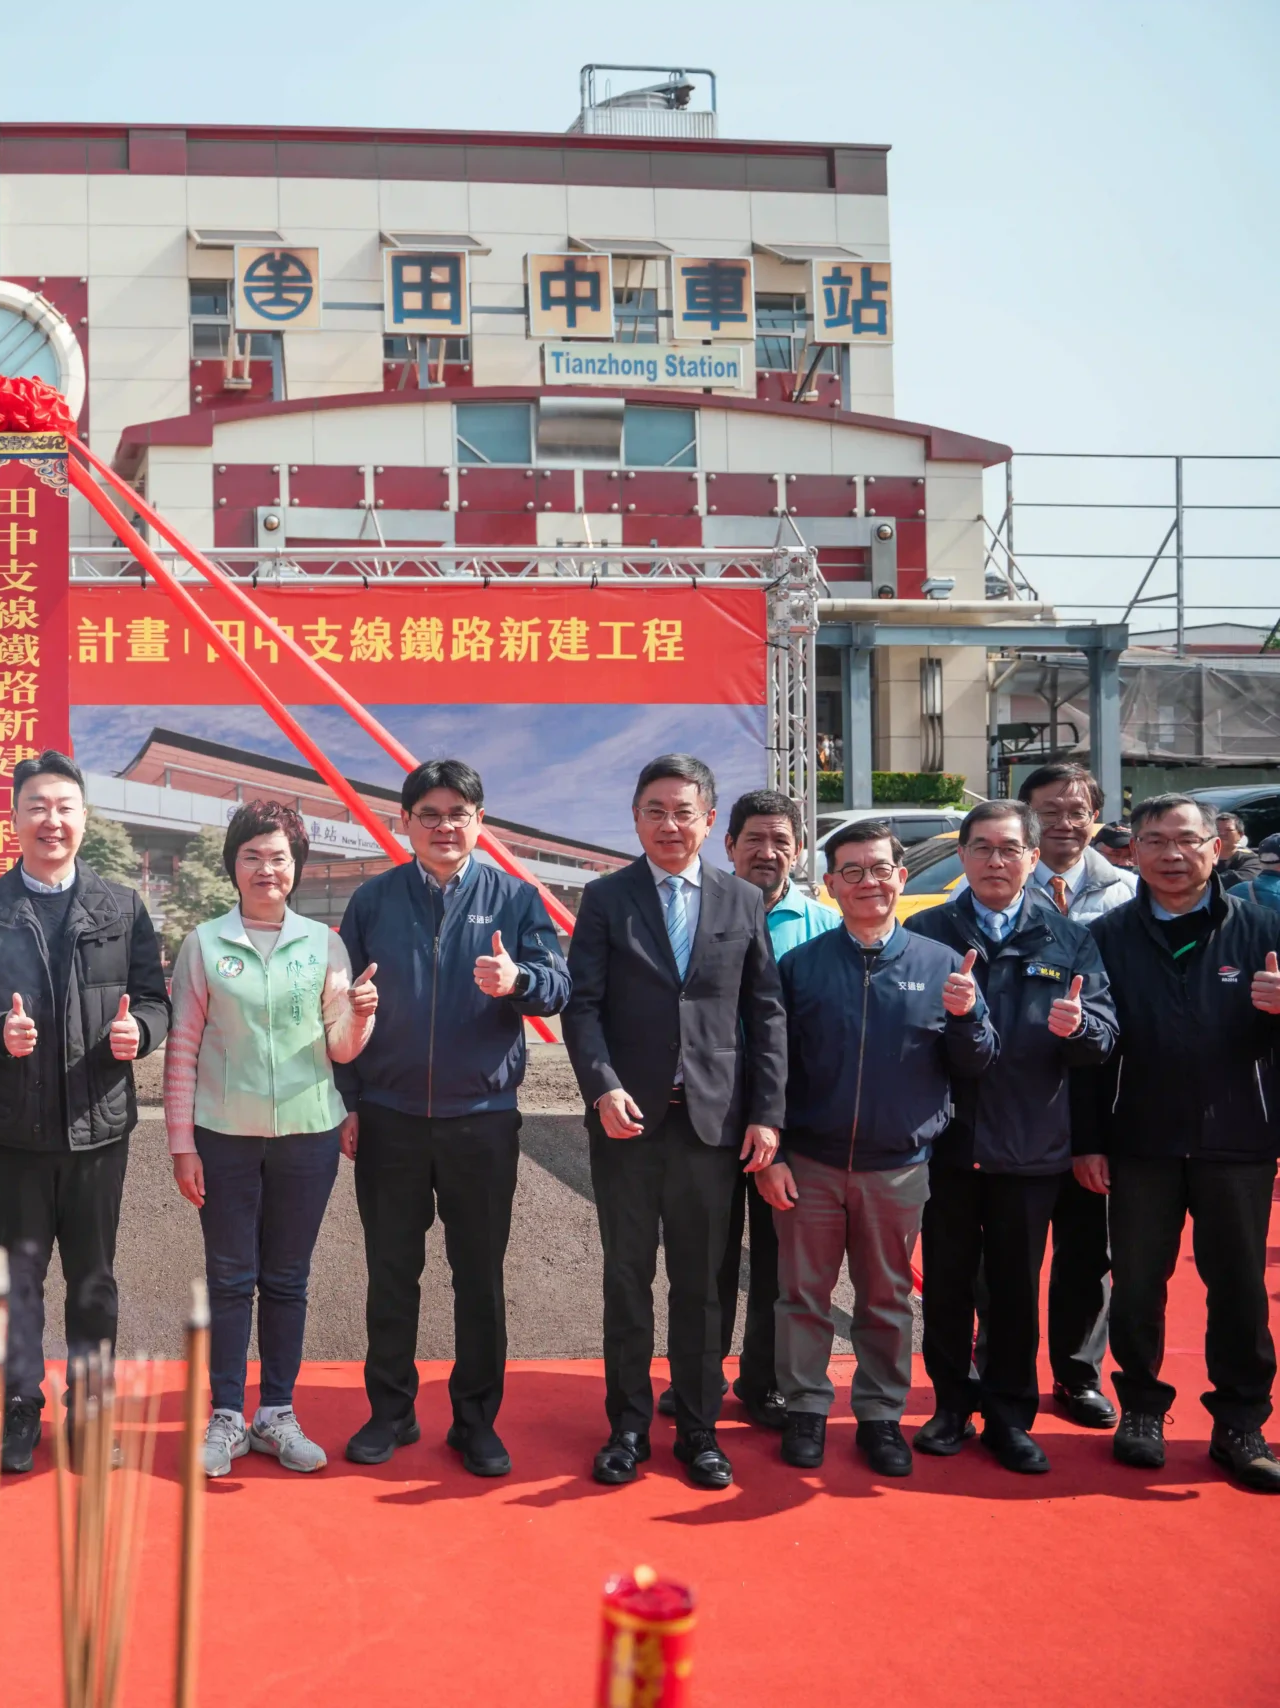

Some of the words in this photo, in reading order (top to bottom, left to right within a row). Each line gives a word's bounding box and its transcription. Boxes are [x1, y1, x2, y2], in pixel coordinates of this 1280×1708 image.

[391, 254, 889, 335] 田中車站
[551, 351, 658, 382] Tianzhong
[665, 354, 738, 378] Station
